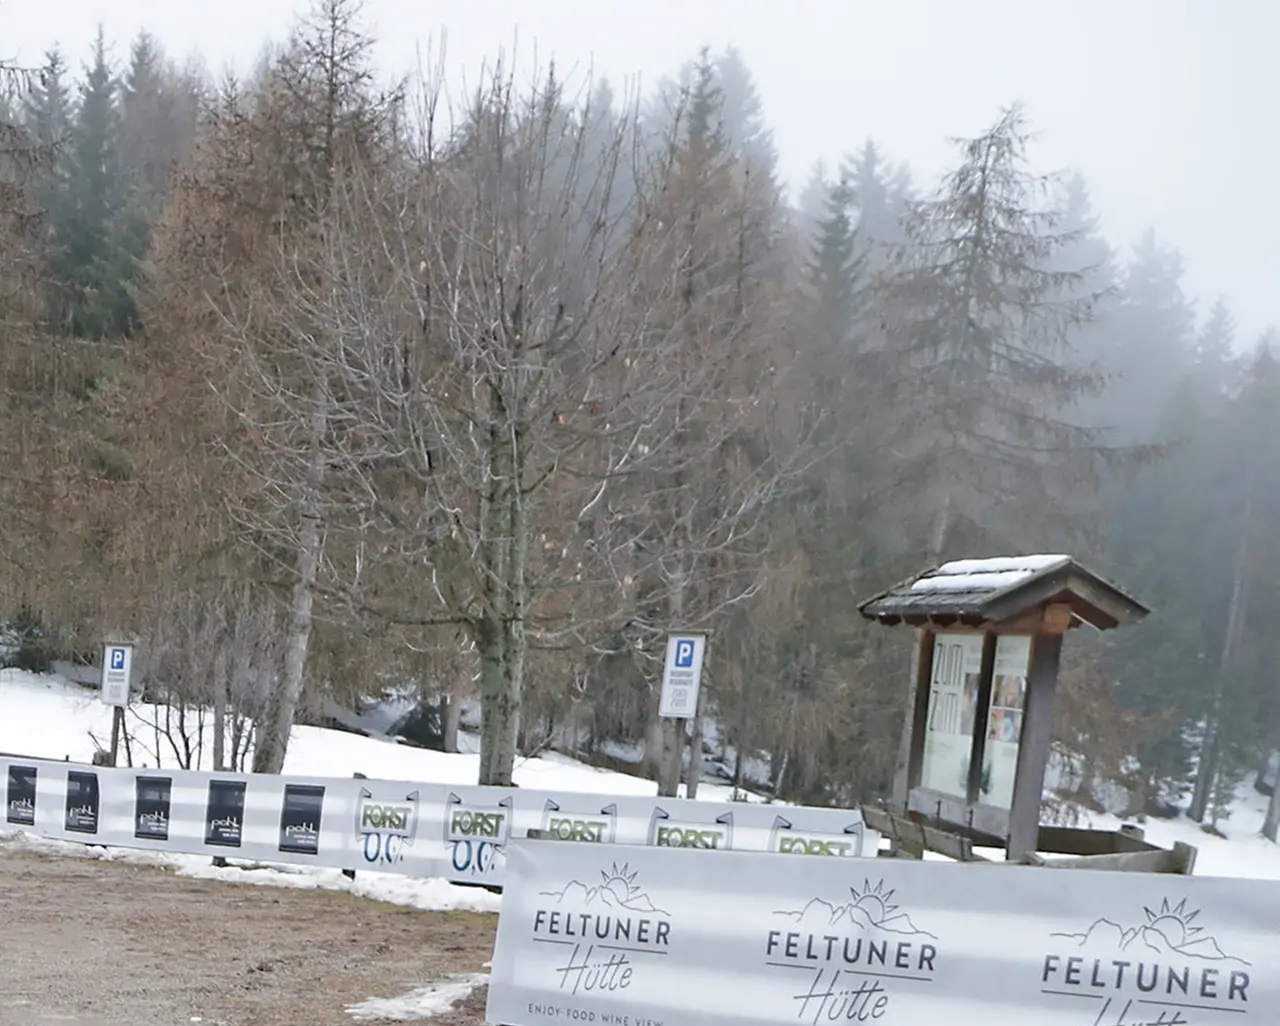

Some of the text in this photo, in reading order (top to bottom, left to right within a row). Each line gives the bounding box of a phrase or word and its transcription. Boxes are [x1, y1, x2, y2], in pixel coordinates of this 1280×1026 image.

[362, 804, 412, 830] FORST
[451, 810, 505, 838] FORST
[534, 910, 670, 945] FELTUNER
[556, 943, 633, 995] Hütte
[766, 931, 937, 971] FELTUNER
[793, 968, 888, 1026] Hütte
[1042, 955, 1251, 1001] FELTUNER
